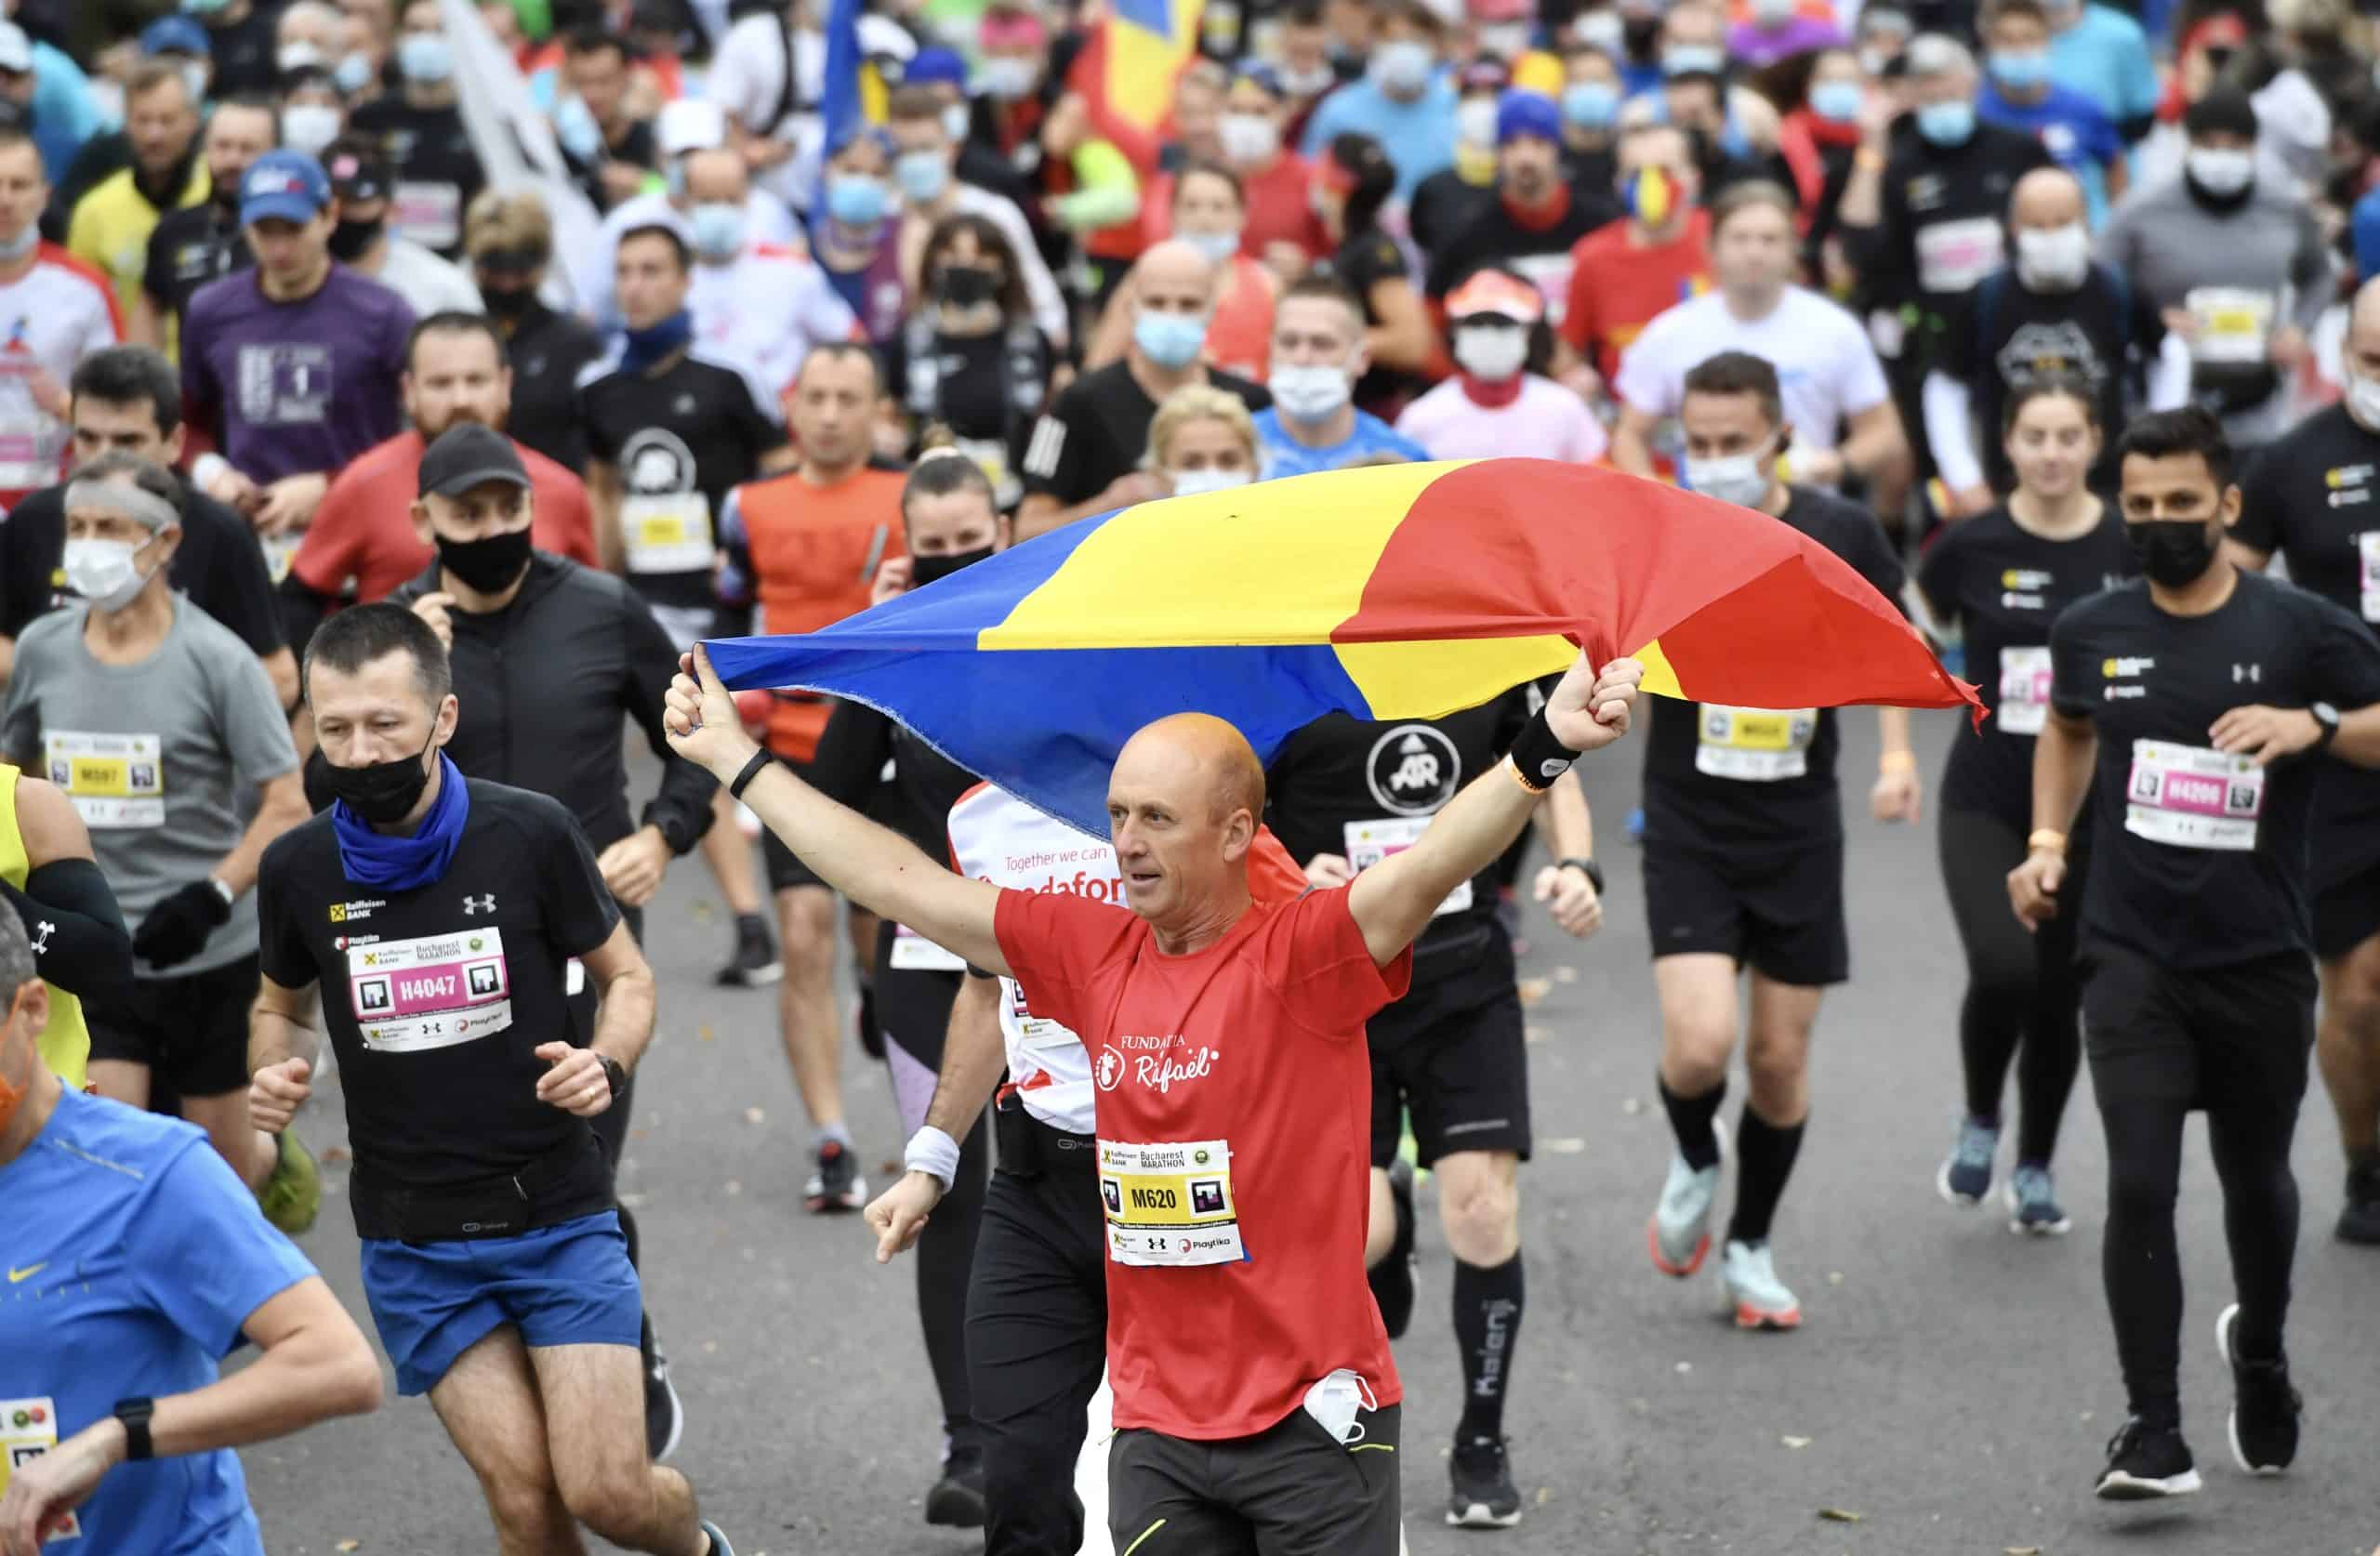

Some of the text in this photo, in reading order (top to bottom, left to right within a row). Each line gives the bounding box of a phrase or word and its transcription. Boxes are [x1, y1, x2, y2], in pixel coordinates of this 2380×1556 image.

[1005, 847, 1107, 874] Together we can
[416, 939, 460, 953] Bucharest
[417, 948, 461, 960] MARATHON
[400, 976, 456, 1001] H4047
[1140, 1150, 1183, 1161] Bucharest
[1141, 1158, 1185, 1168] MARATHON
[1130, 1189, 1177, 1209] M620
[1192, 1237, 1232, 1250] Playtika
